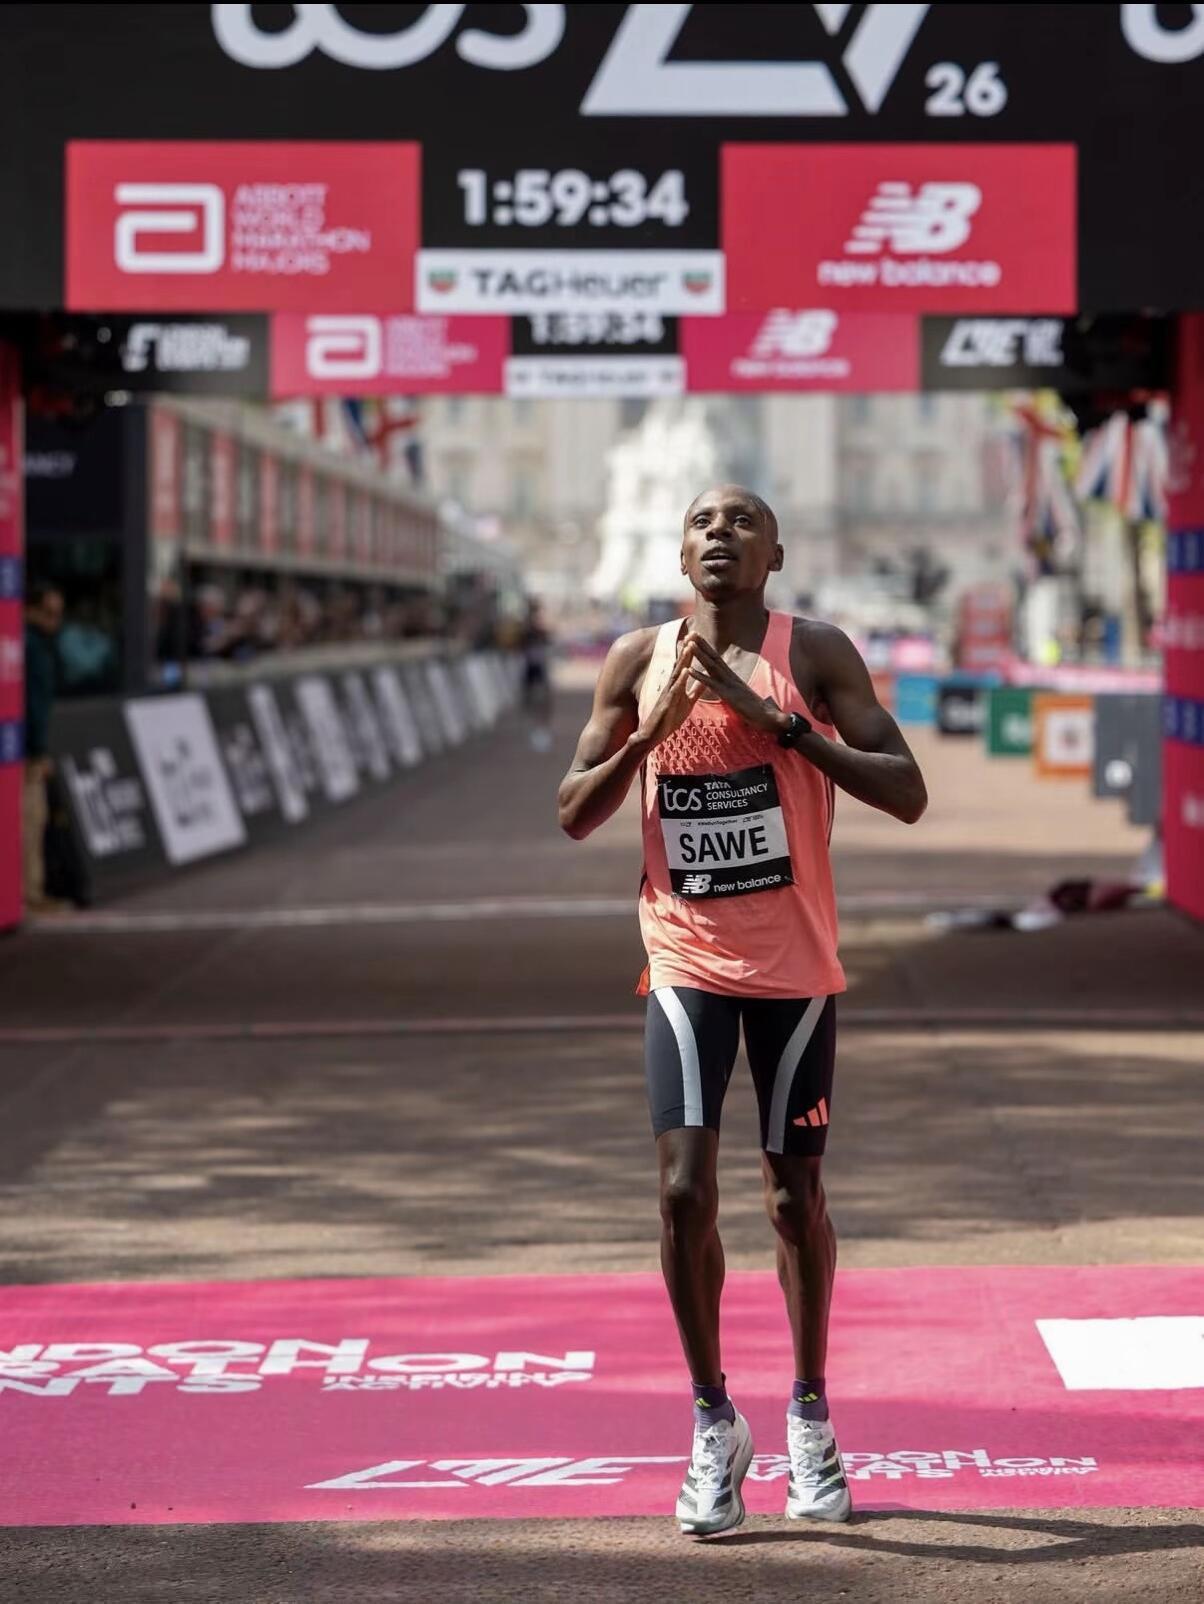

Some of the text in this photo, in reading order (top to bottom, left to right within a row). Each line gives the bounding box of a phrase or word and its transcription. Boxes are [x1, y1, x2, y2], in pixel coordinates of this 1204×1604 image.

[925, 62, 1008, 116] 26
[458, 169, 689, 227] 1:59:34
[817, 258, 1001, 286] new balance
[663, 782, 703, 812] tcs
[704, 781, 732, 791] TATA
[705, 783, 769, 801] CONSULTANCY
[706, 799, 748, 811] SERVICES
[679, 825, 769, 864] SAWE
[713, 873, 782, 893] new balance
